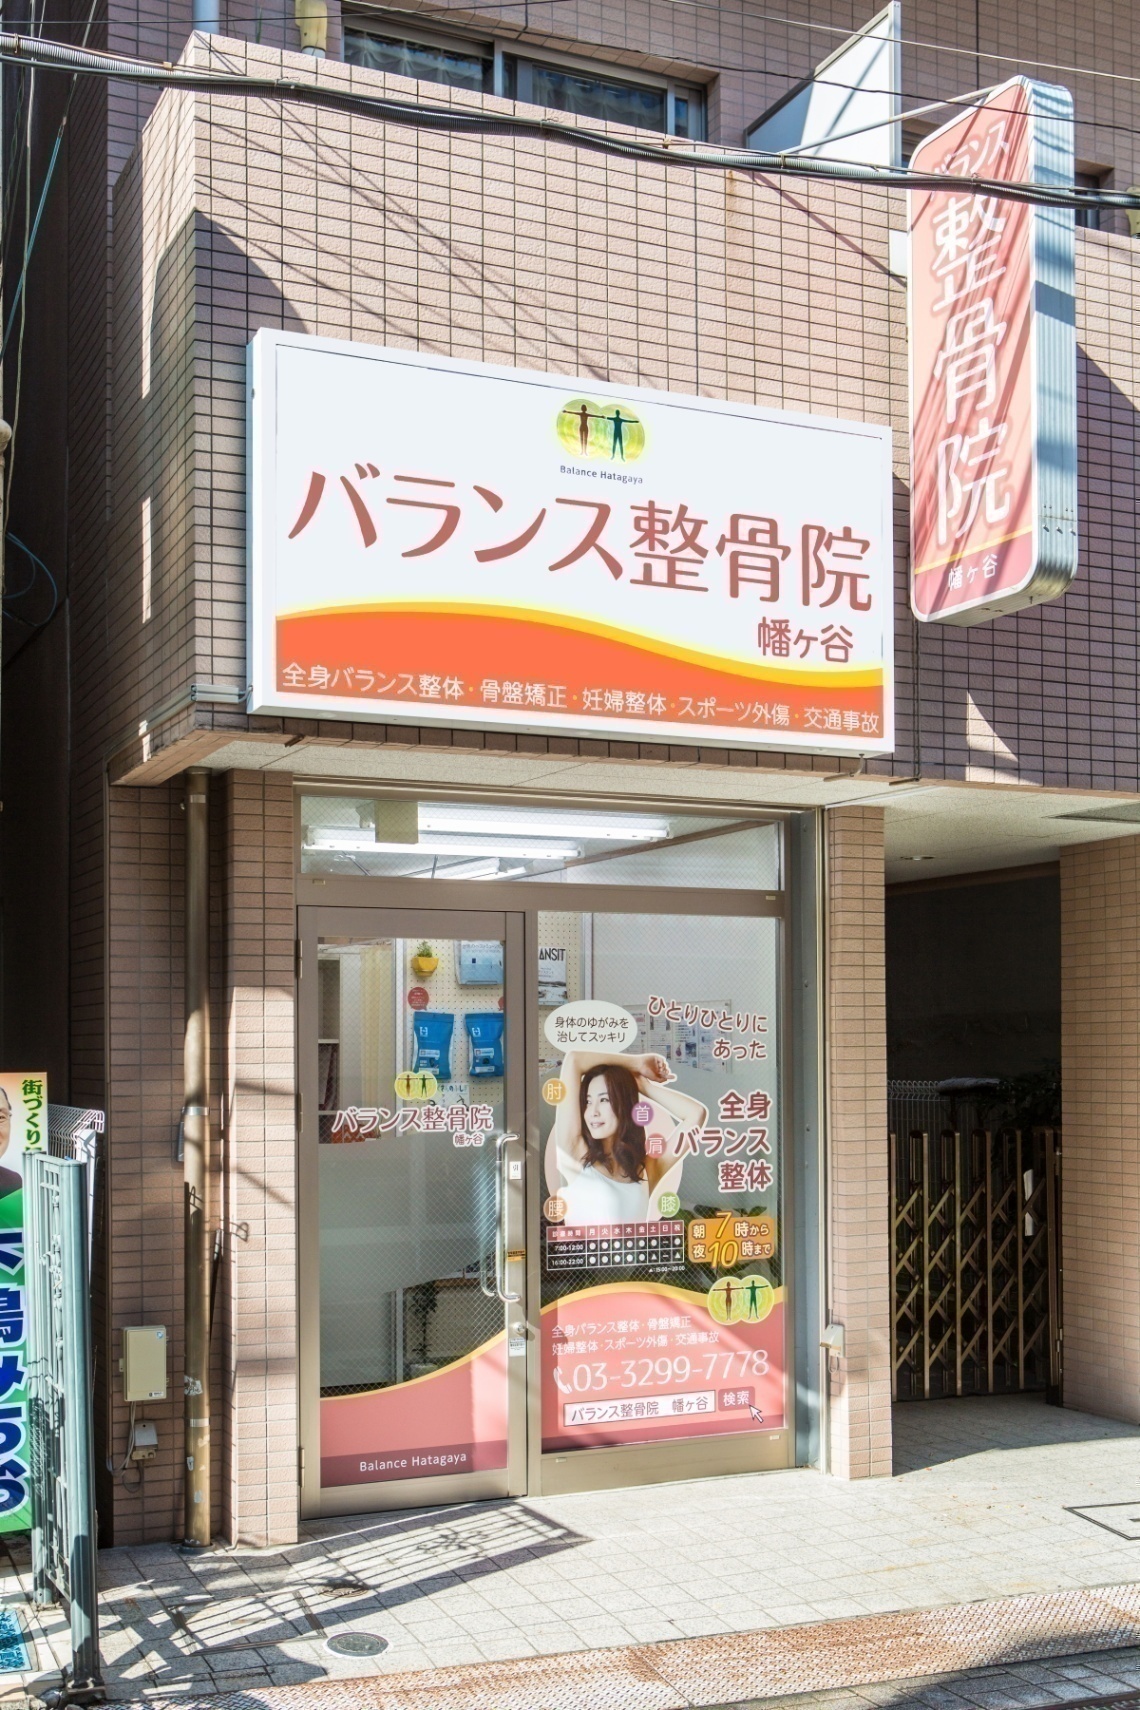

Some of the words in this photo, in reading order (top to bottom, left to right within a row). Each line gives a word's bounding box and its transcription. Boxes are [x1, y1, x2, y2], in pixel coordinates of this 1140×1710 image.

[932, 193, 1011, 546] 整骨院
[560, 465, 598, 478] Balance
[600, 471, 643, 485] Hatagaya
[288, 462, 873, 612] バランス整骨院
[757, 616, 854, 664] 幡ヶ谷
[555, 1016, 629, 1029] 身体のゆがみを
[648, 996, 768, 1033] ひとりひとりに
[557, 1031, 626, 1043] 治してスッキリ
[713, 1039, 767, 1059] あった
[547, 1083, 562, 1099] 肘
[22, 1079, 43, 1151] 街づくり
[635, 1105, 650, 1122] 首
[720, 1091, 771, 1120] 全身
[333, 1106, 493, 1132] バランス整骨院
[647, 1137, 664, 1155] 肩
[674, 1128, 771, 1155] バランス
[720, 1161, 771, 1190] 整体
[548, 1200, 564, 1217] 腰
[661, 1196, 676, 1213] 膝
[589, 1228, 595, 1236] 月
[613, 1227, 620, 1235] 水
[625, 1226, 632, 1234] 木
[650, 1225, 656, 1233] 土
[573, 1350, 769, 1392] 03-3299-7778
[723, 1391, 750, 1407] 検索
[571, 1401, 659, 1422] バランス整骨院
[360, 1458, 407, 1471] Balance
[412, 1452, 467, 1466] Hatagaya
